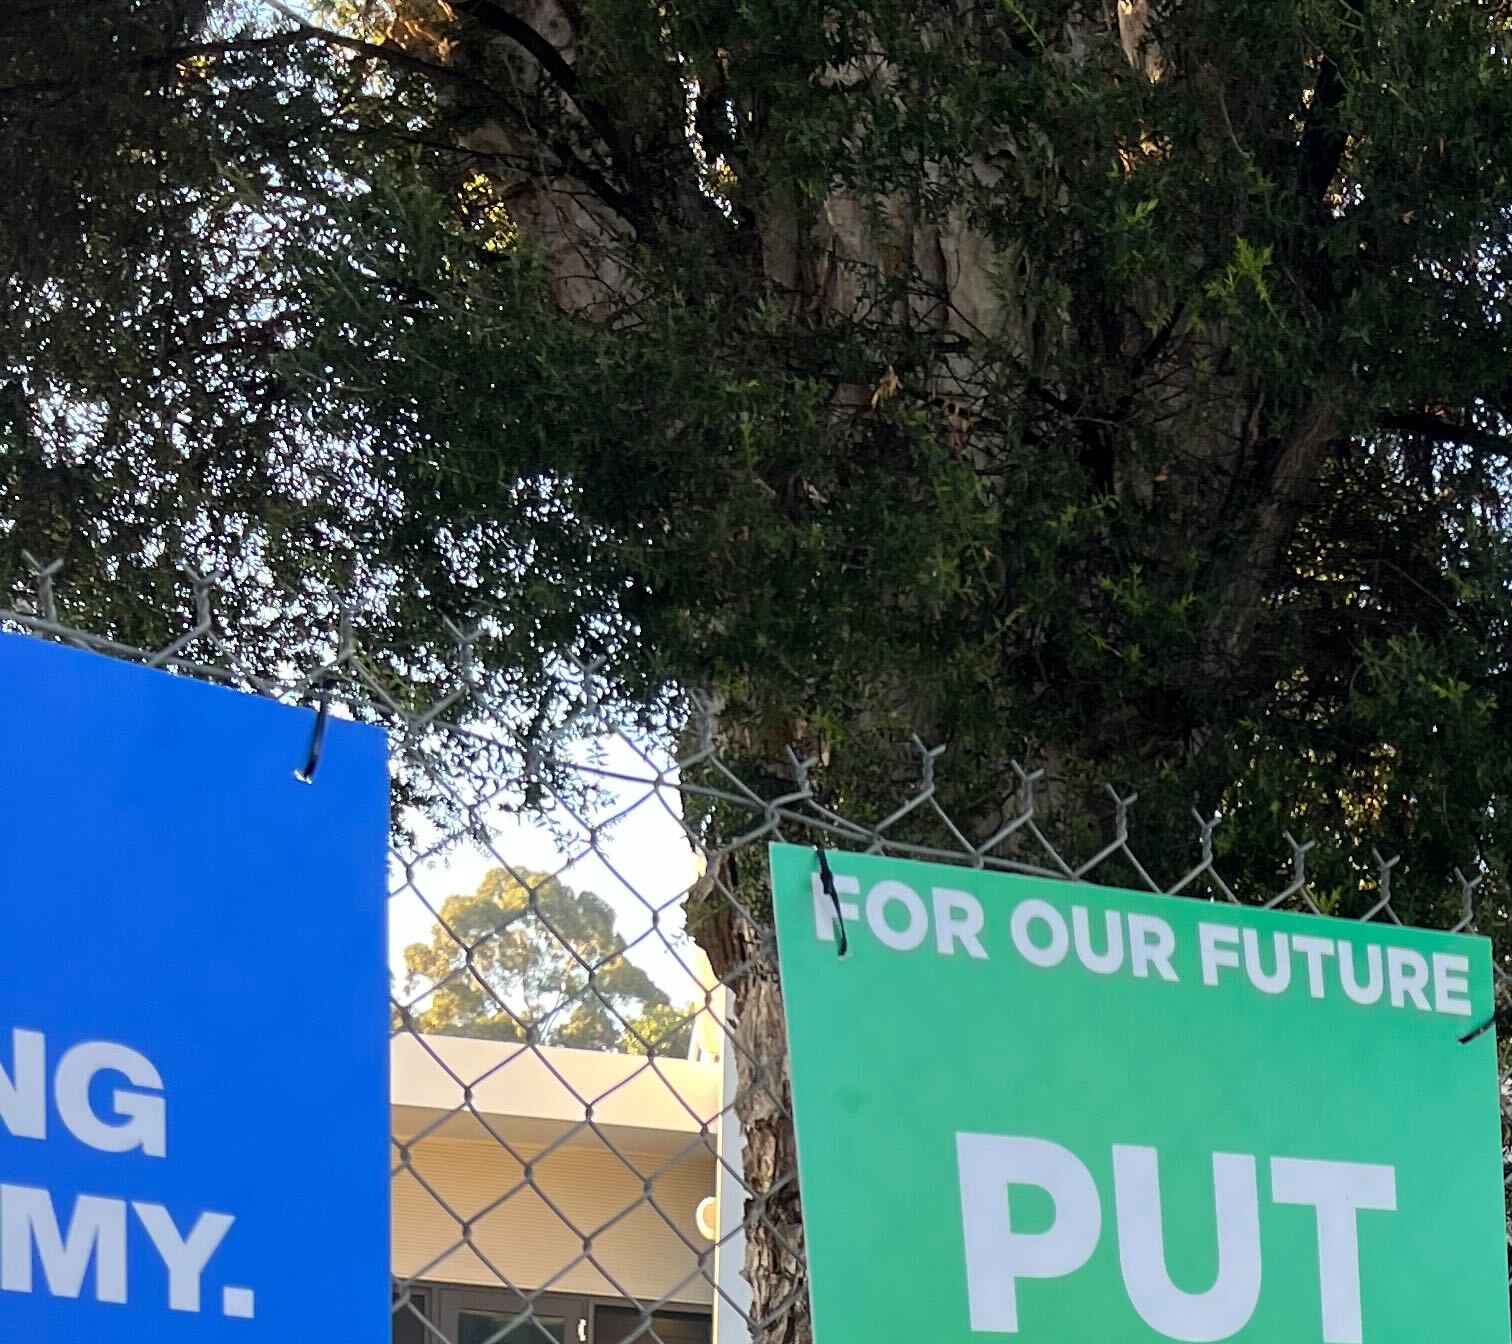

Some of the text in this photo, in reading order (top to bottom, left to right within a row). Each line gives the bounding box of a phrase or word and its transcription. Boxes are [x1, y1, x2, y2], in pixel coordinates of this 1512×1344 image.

[811, 871, 1473, 1017] FOR OUR FUTURE
[0, 1183, 255, 1319] MY.
[955, 1131, 1398, 1344] PUT
